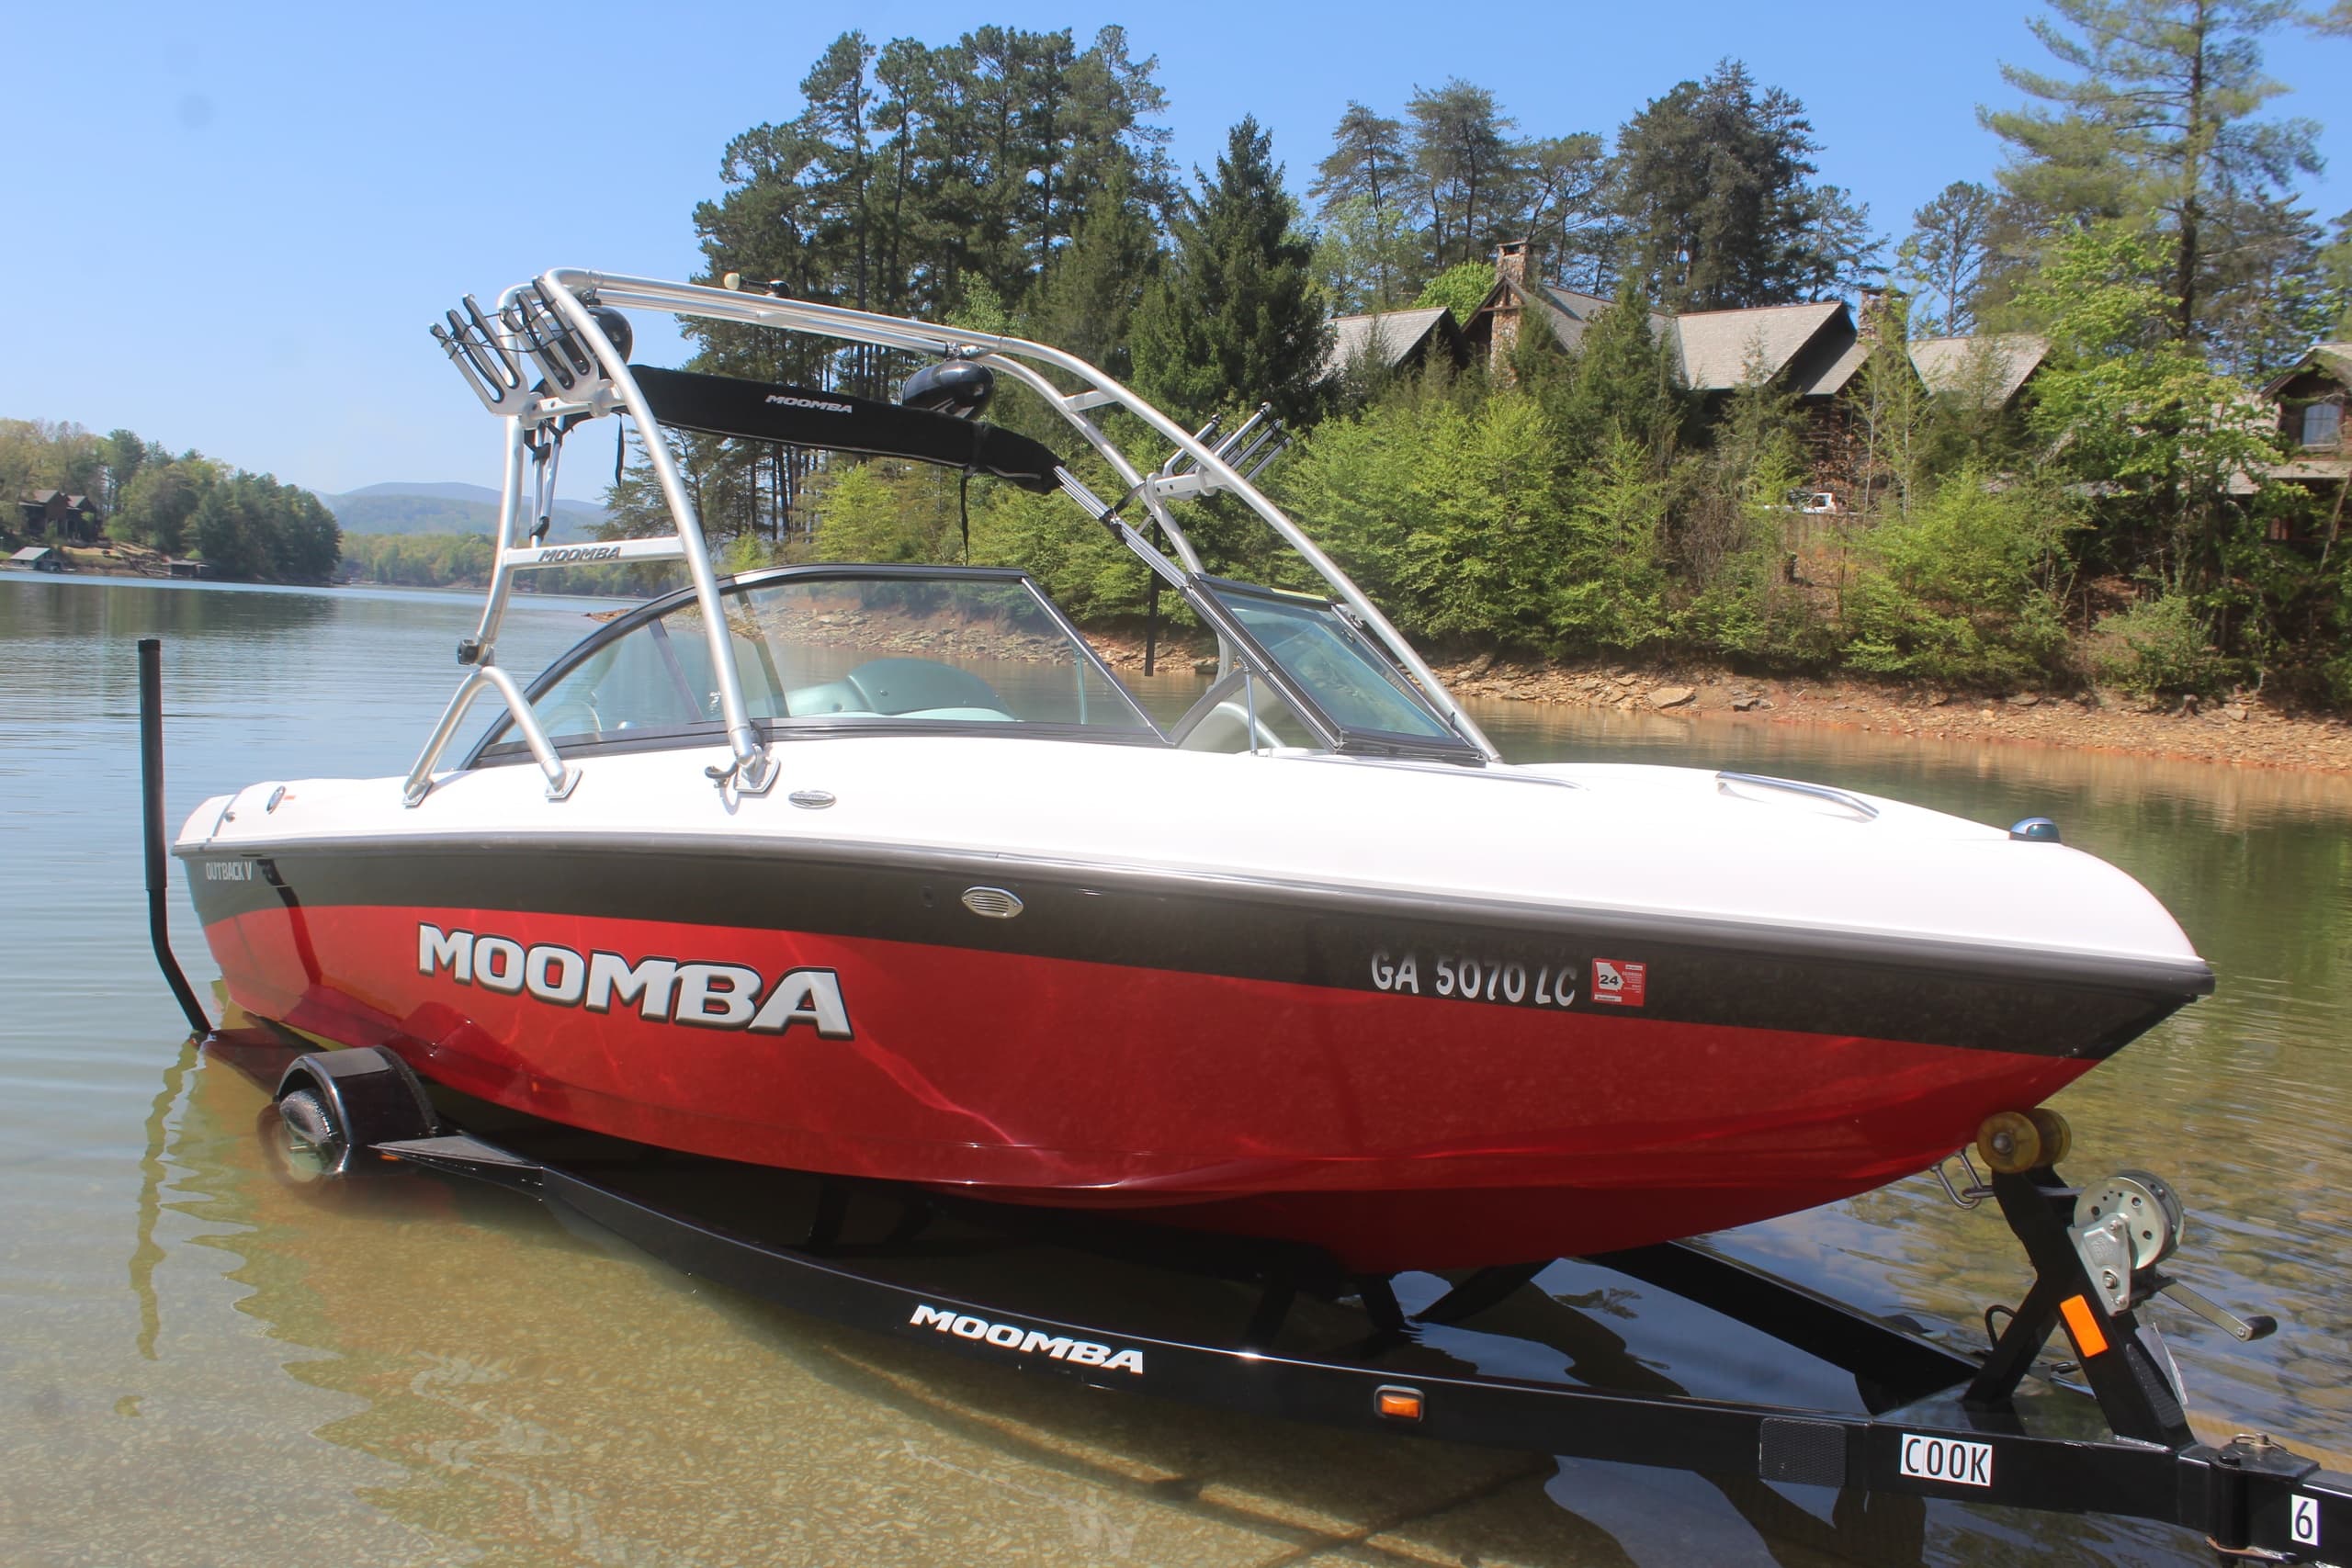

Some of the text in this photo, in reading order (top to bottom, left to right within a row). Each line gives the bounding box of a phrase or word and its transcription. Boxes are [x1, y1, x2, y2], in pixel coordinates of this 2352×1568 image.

[765, 394, 853, 413] MOOMBA
[538, 547, 621, 562] MOOMBA
[206, 861, 252, 881] OUTBACK V
[419, 922, 853, 1039] MOOMBA
[1372, 950, 1577, 1007] GA 5070 LC
[1600, 974, 1619, 985] 24
[910, 1304, 1143, 1374] MOOMBA
[1905, 1438, 1989, 1483] COOK
[2295, 1500, 2312, 1540] 6
